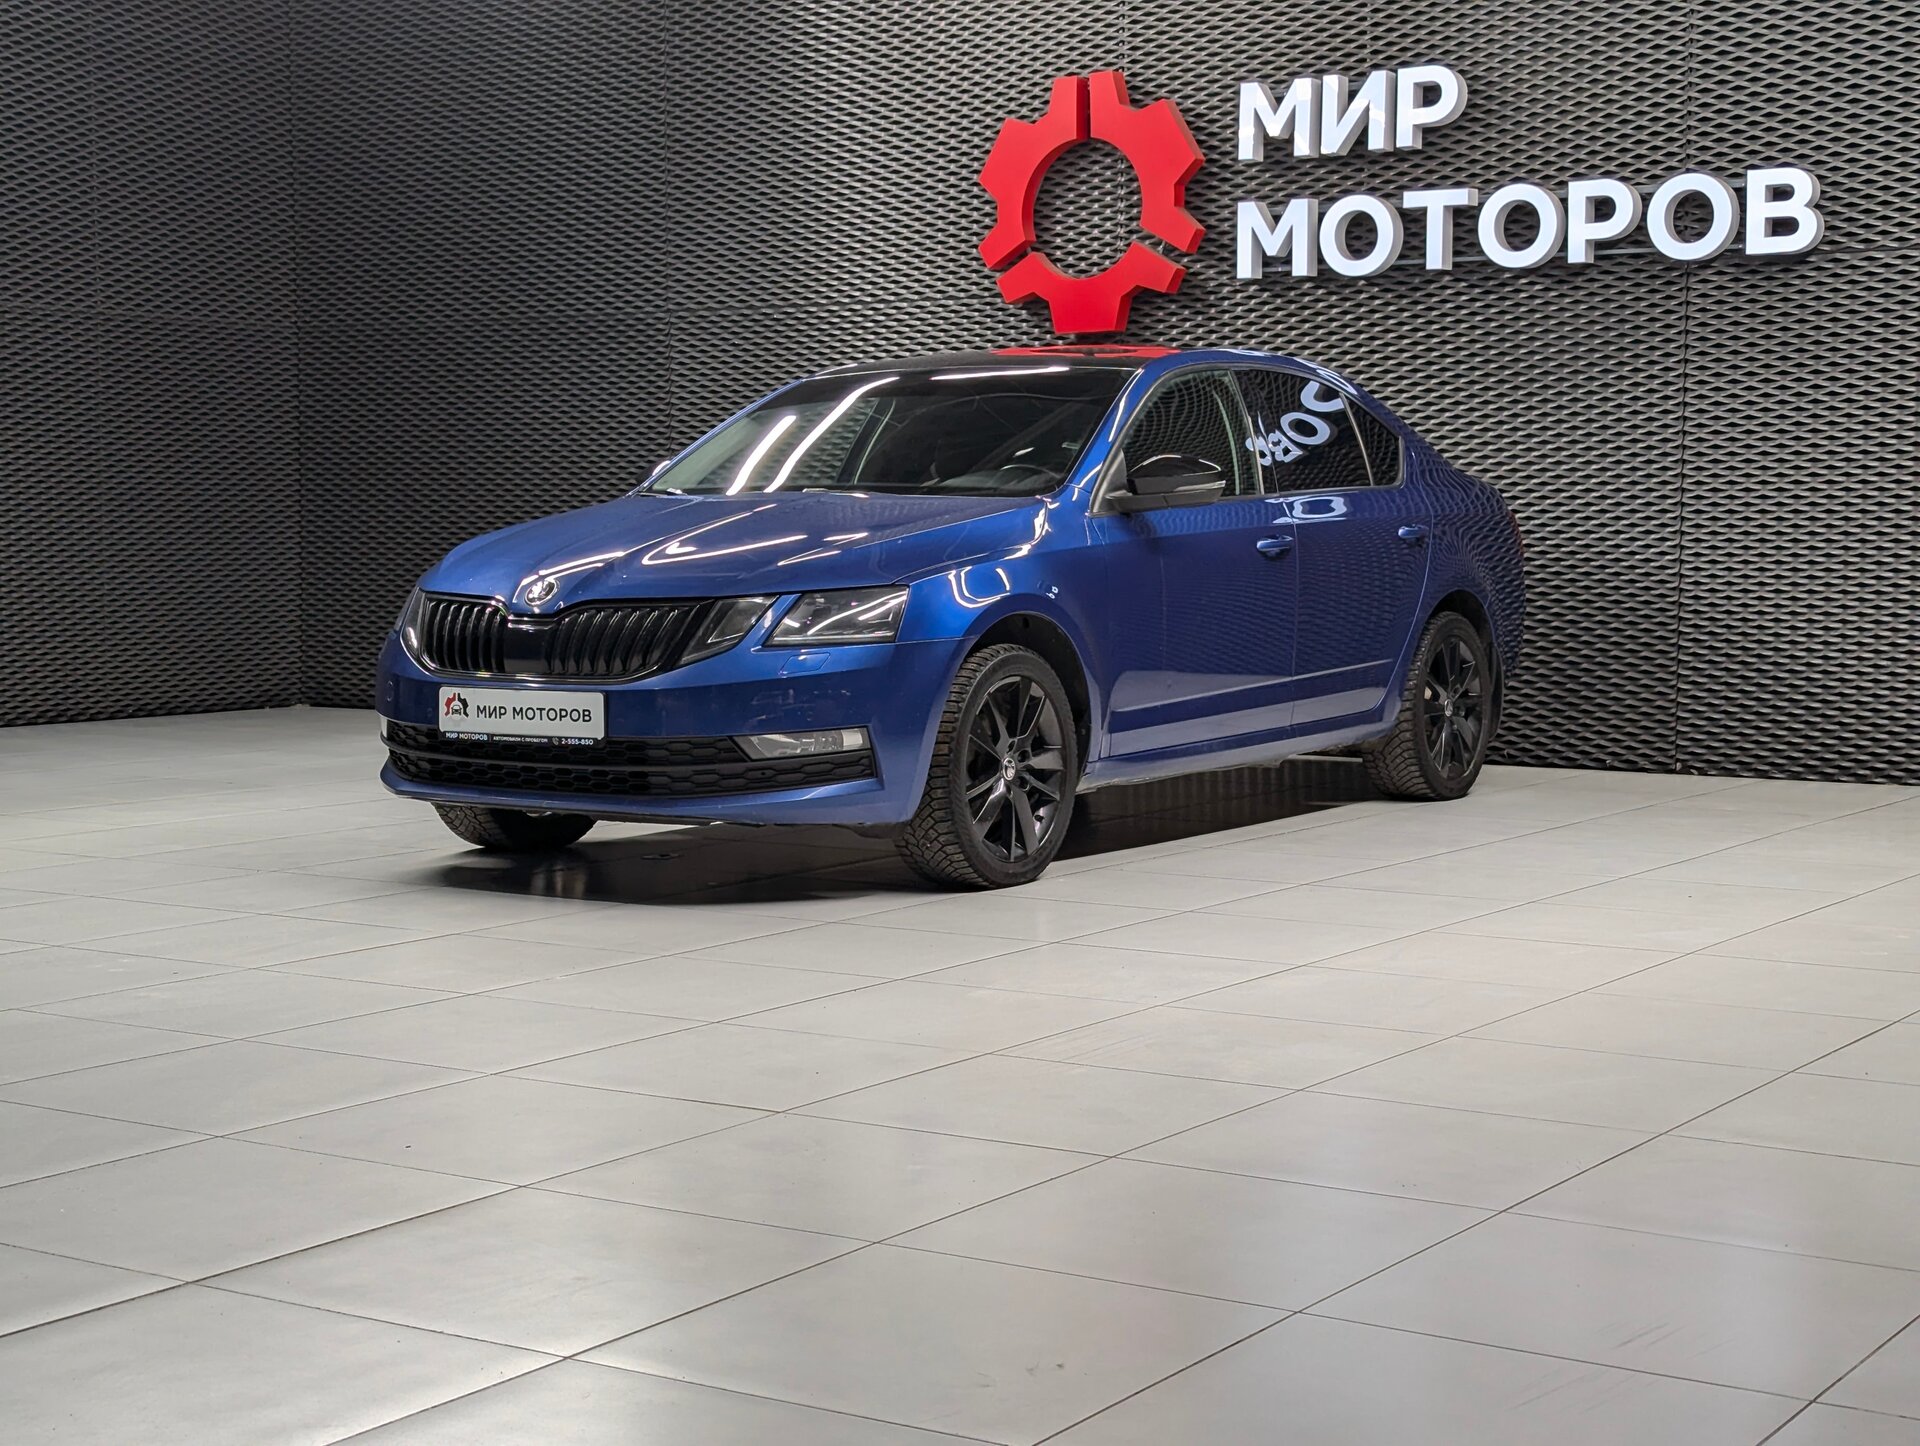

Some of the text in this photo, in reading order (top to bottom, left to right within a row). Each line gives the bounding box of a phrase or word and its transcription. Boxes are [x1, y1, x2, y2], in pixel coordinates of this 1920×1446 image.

[1238, 65, 1467, 161] МИР
[1237, 167, 1824, 280] МОТОРОВ
[459, 733, 488, 741] МОТОРОВ
[476, 704, 592, 723] МИР МОТОРОВ
